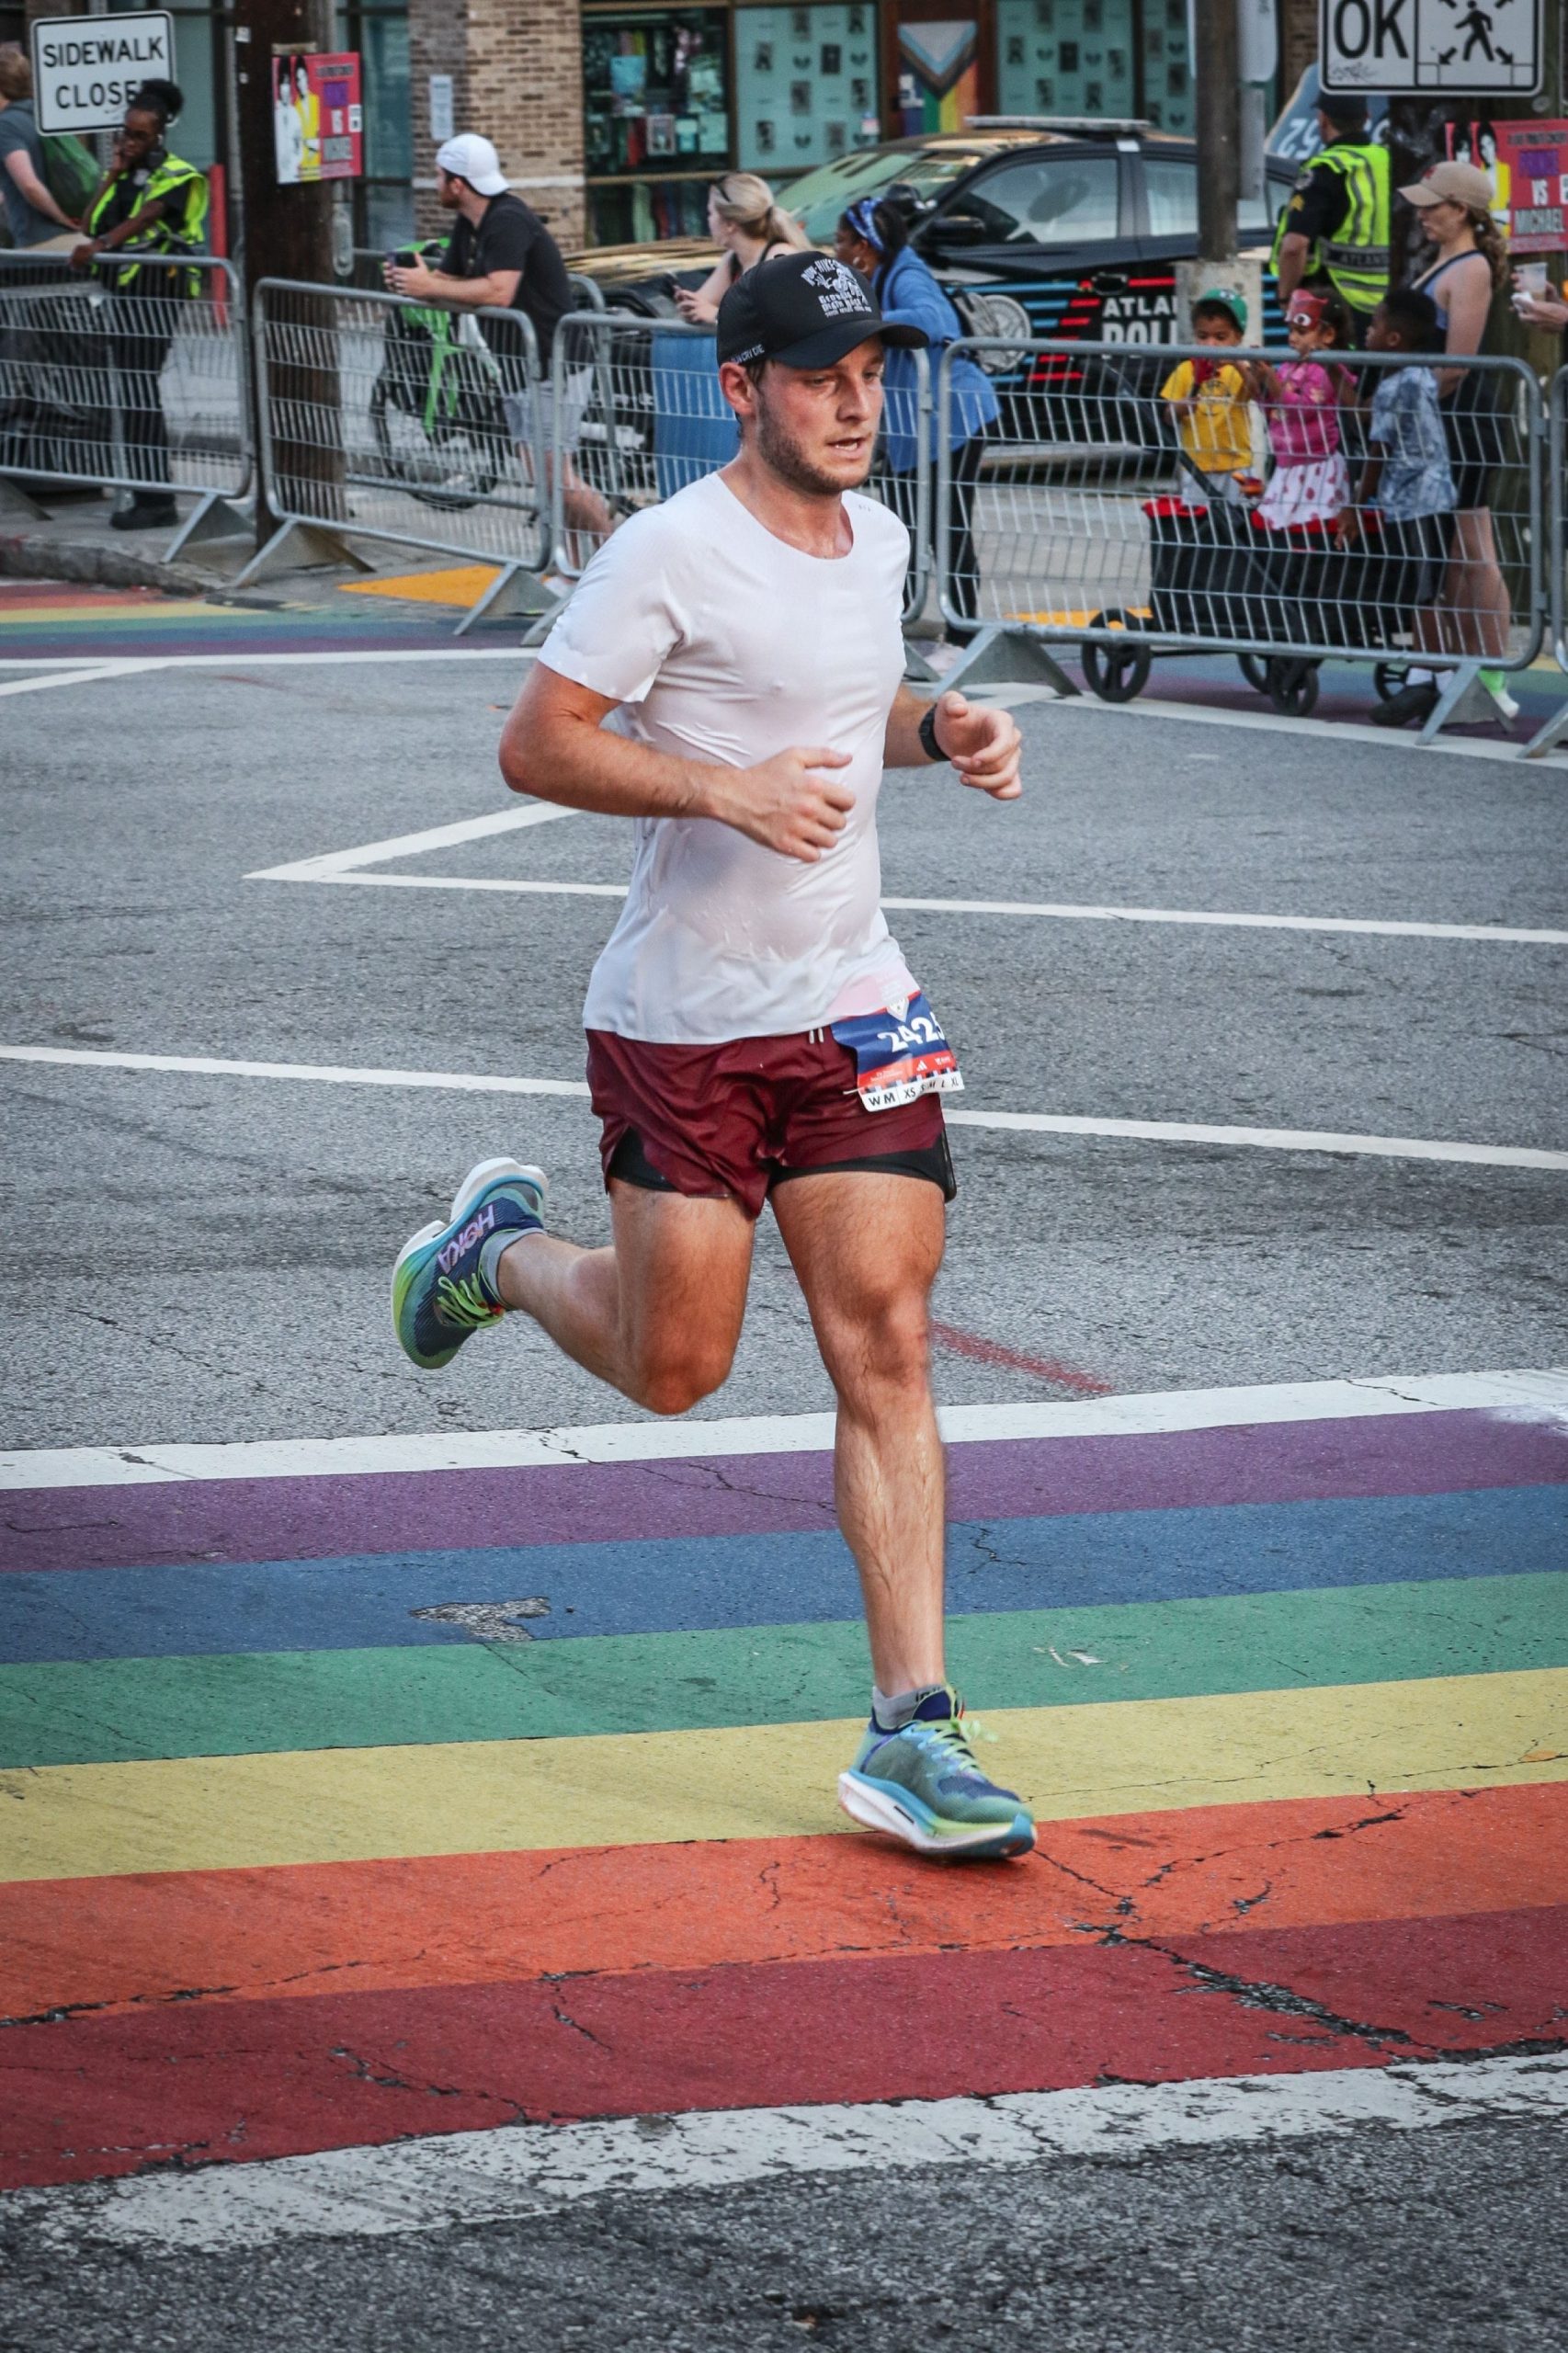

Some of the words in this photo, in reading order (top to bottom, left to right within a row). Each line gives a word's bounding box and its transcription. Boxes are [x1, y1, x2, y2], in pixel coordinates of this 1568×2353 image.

[1334, 0, 1409, 60] OK
[42, 36, 165, 69] SIDEWALK
[55, 78, 139, 109] CLOSE
[903, 1086, 916, 1099] XS
[950, 1077, 960, 1086] XL
[437, 1203, 495, 1275] HOKA
